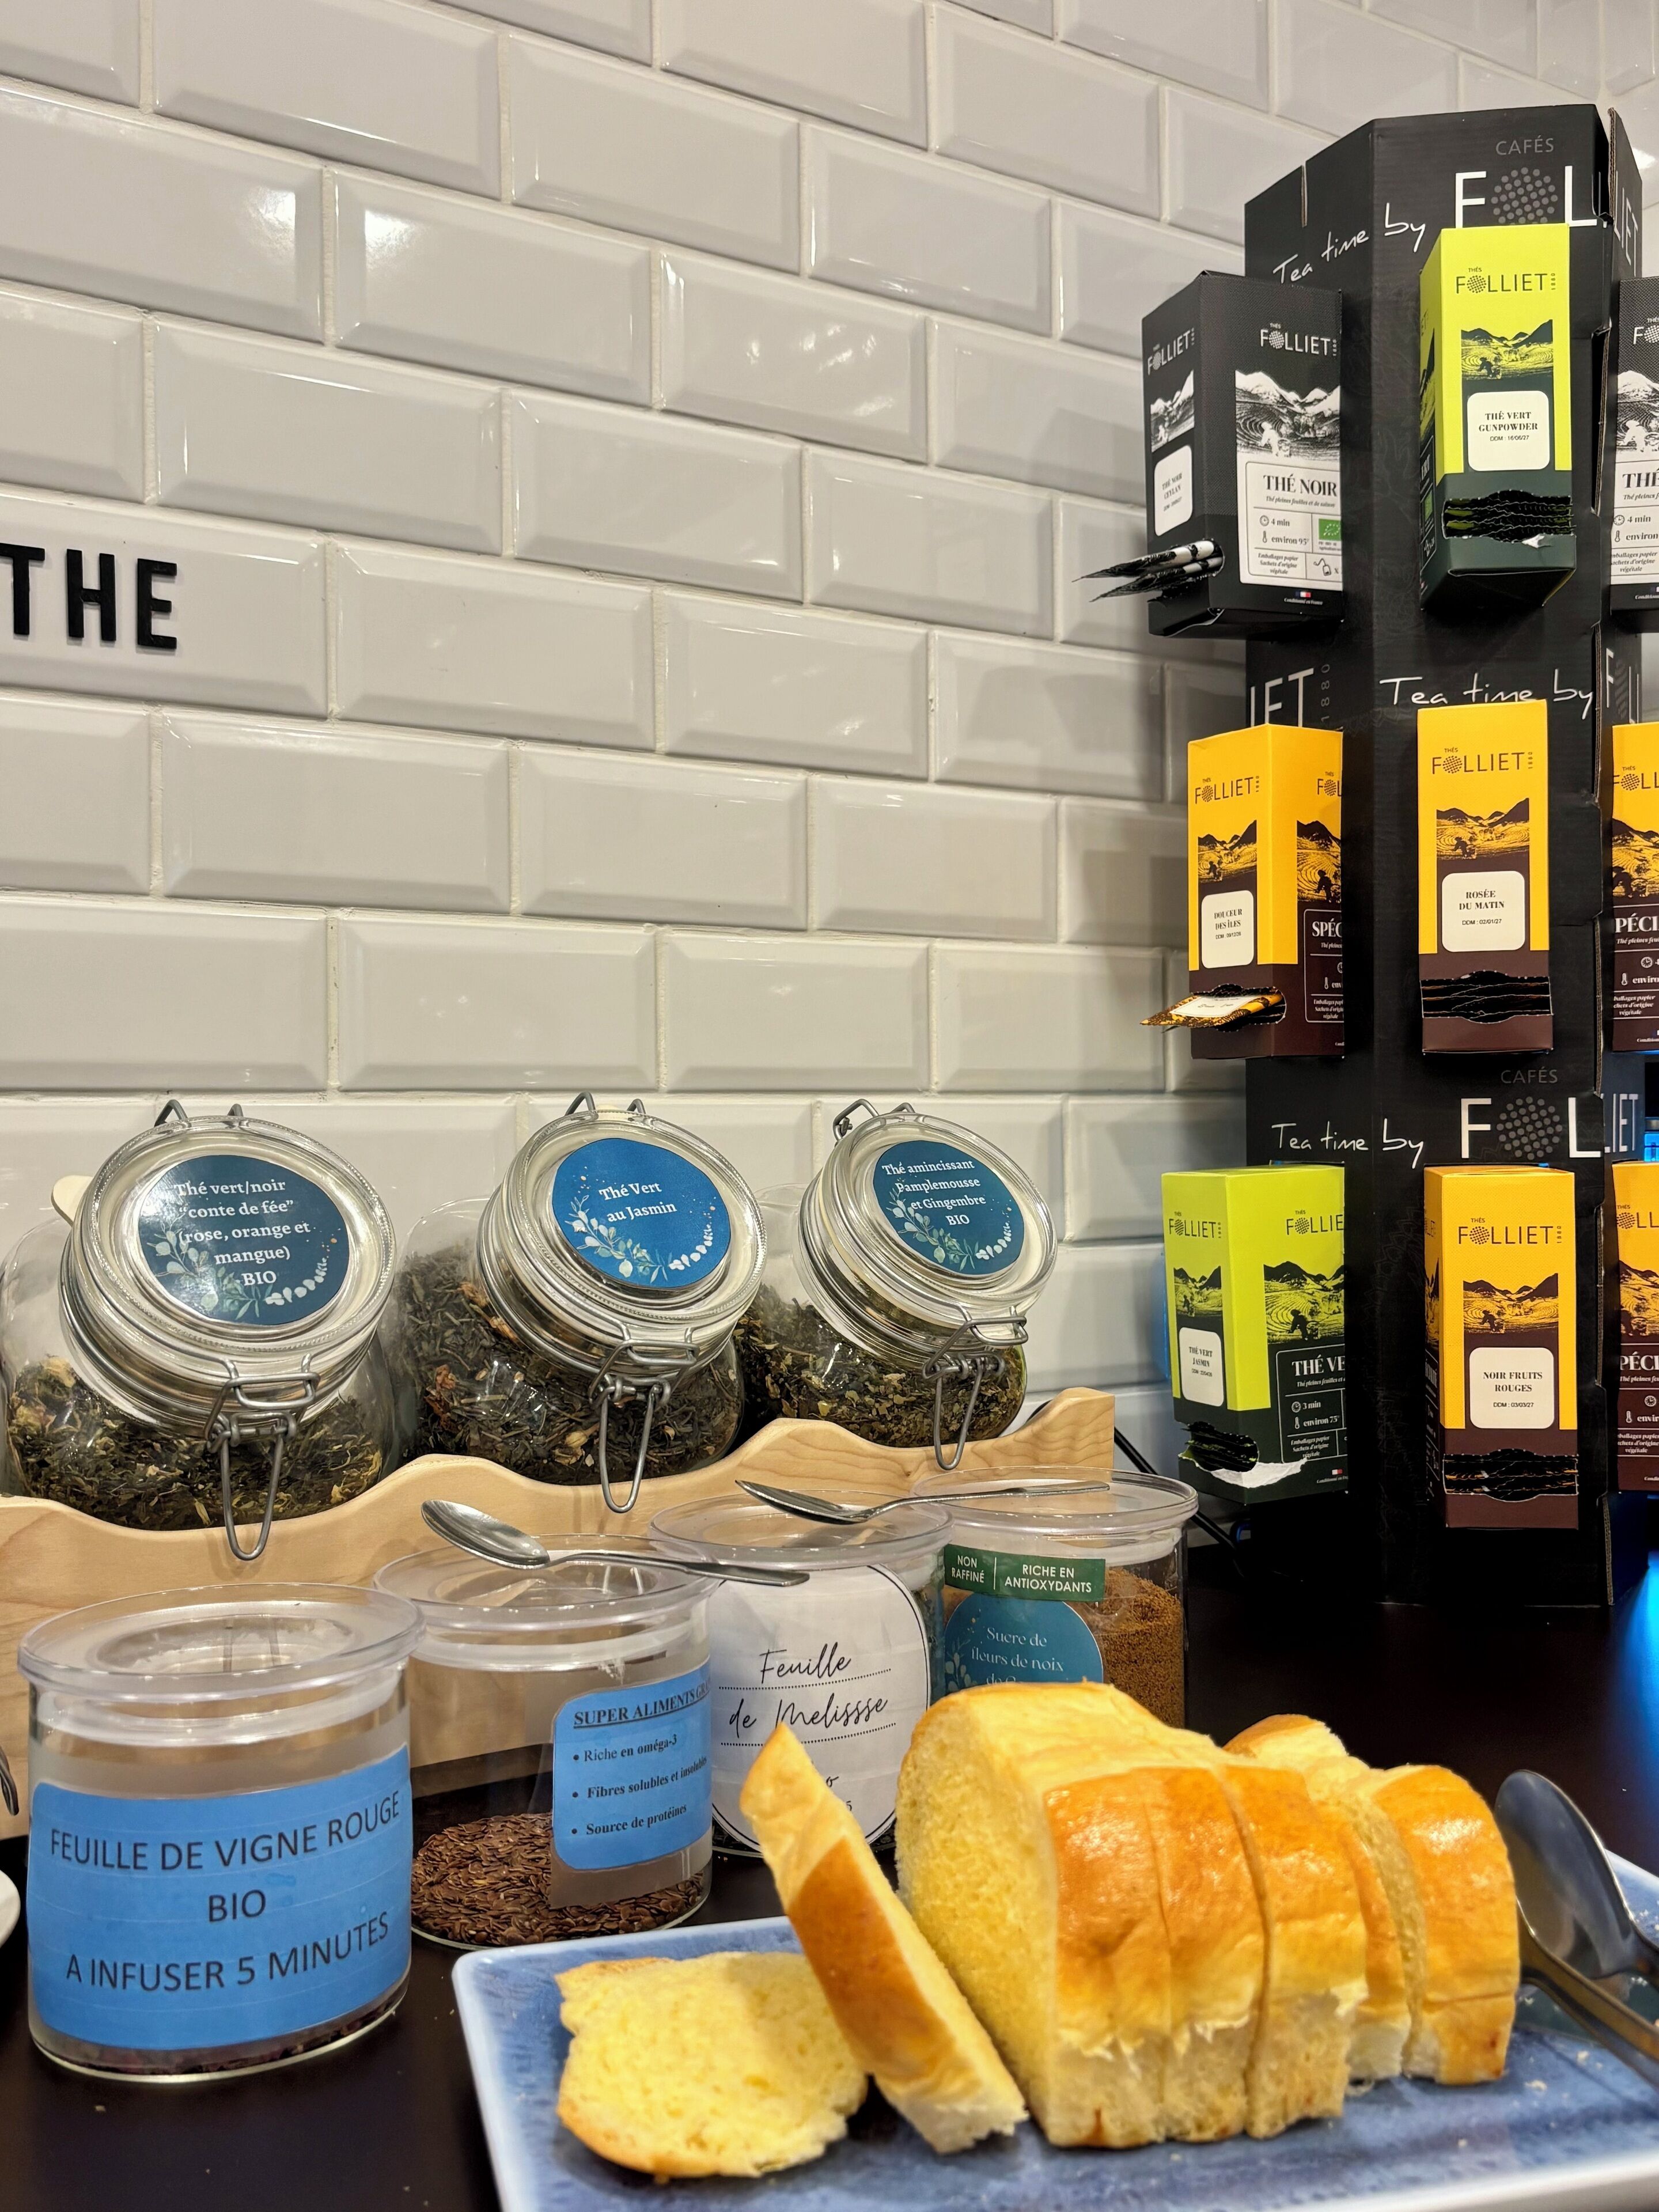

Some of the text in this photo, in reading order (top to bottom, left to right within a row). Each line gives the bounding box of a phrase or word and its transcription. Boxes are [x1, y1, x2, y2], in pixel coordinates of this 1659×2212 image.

[1495, 138, 1554, 156] CAFÉS
[1273, 203, 1426, 285] Tea time by
[1456, 273, 1548, 294] FOLLIET
[1260, 329, 1331, 355] FOLLIET
[1147, 330, 1191, 376] FOLLIET
[1484, 410, 1531, 421] THÉ VERT
[1478, 422, 1538, 433] GUNPOWDER
[1263, 474, 1338, 497] THÉ NOIR
[1634, 514, 1651, 523] min
[1271, 536, 1297, 545] environ
[1626, 532, 1658, 541] environ
[0, 543, 177, 650] THE
[1380, 668, 1595, 719] Tea time by
[1432, 752, 1525, 774] FOLLIET
[1195, 777, 1253, 804] FOLLIET
[1465, 889, 1496, 899] ROSÉE
[1214, 908, 1243, 919] DOUCEUR
[1459, 901, 1505, 911] DU MATIN
[1215, 922, 1226, 930] DES
[1500, 1066, 1558, 1084] CAFÉS
[1271, 1118, 1424, 1169] Tea time by
[882, 1160, 975, 1175] Thé amincissant
[174, 1179, 286, 1196] Thé vert/noir
[599, 1181, 662, 1201] Thé Vert
[895, 1179, 981, 1193] Pamplemousse
[238, 1202, 259, 1216] de
[923, 1195, 986, 1209] Gingembre
[607, 1202, 677, 1222] au Jasmin
[945, 1214, 970, 1225] BIO
[178, 1222, 311, 1245] (rose, orange et
[1169, 1218, 1217, 1238] FOLLIET
[1458, 1225, 1554, 1245] FOLLIET
[214, 1245, 291, 1265] mangue)
[241, 1270, 277, 1286] BIO
[1188, 1346, 1213, 1358] THÉ VERT
[1192, 1358, 1210, 1367] JASMIN
[1291, 1354, 1324, 1376] THÉ
[1483, 1371, 1543, 1380] NOIR FRUITS
[1494, 1384, 1532, 1392] ROUGES
[1308, 1401, 1321, 1409] min
[1303, 1418, 1329, 1427] environ
[957, 1554, 978, 1569] NON
[1022, 1563, 1074, 1578] RICHE EN
[951, 1567, 985, 1584] RAFFINÉ
[1005, 1575, 1092, 1593] ANTIOXYDANTS
[987, 1627, 1047, 1647] Sucre de
[759, 1642, 851, 1684] Feuille
[972, 1646, 1064, 1672] fleurs de noix
[574, 1688, 695, 1726] SUPER ALIMENTS
[729, 1698, 757, 1738] de
[584, 1734, 677, 1762] Riche en oméga-3
[588, 1756, 707, 1798] Fibres solubles et insolubles
[586, 1804, 687, 1835] Source de protéines
[51, 1790, 399, 1870] FEUILLE DE VIGNE ROUGE
[208, 1889, 266, 1923] BIO
[66, 1911, 389, 1991] A INFUSER 5 MINUTES
